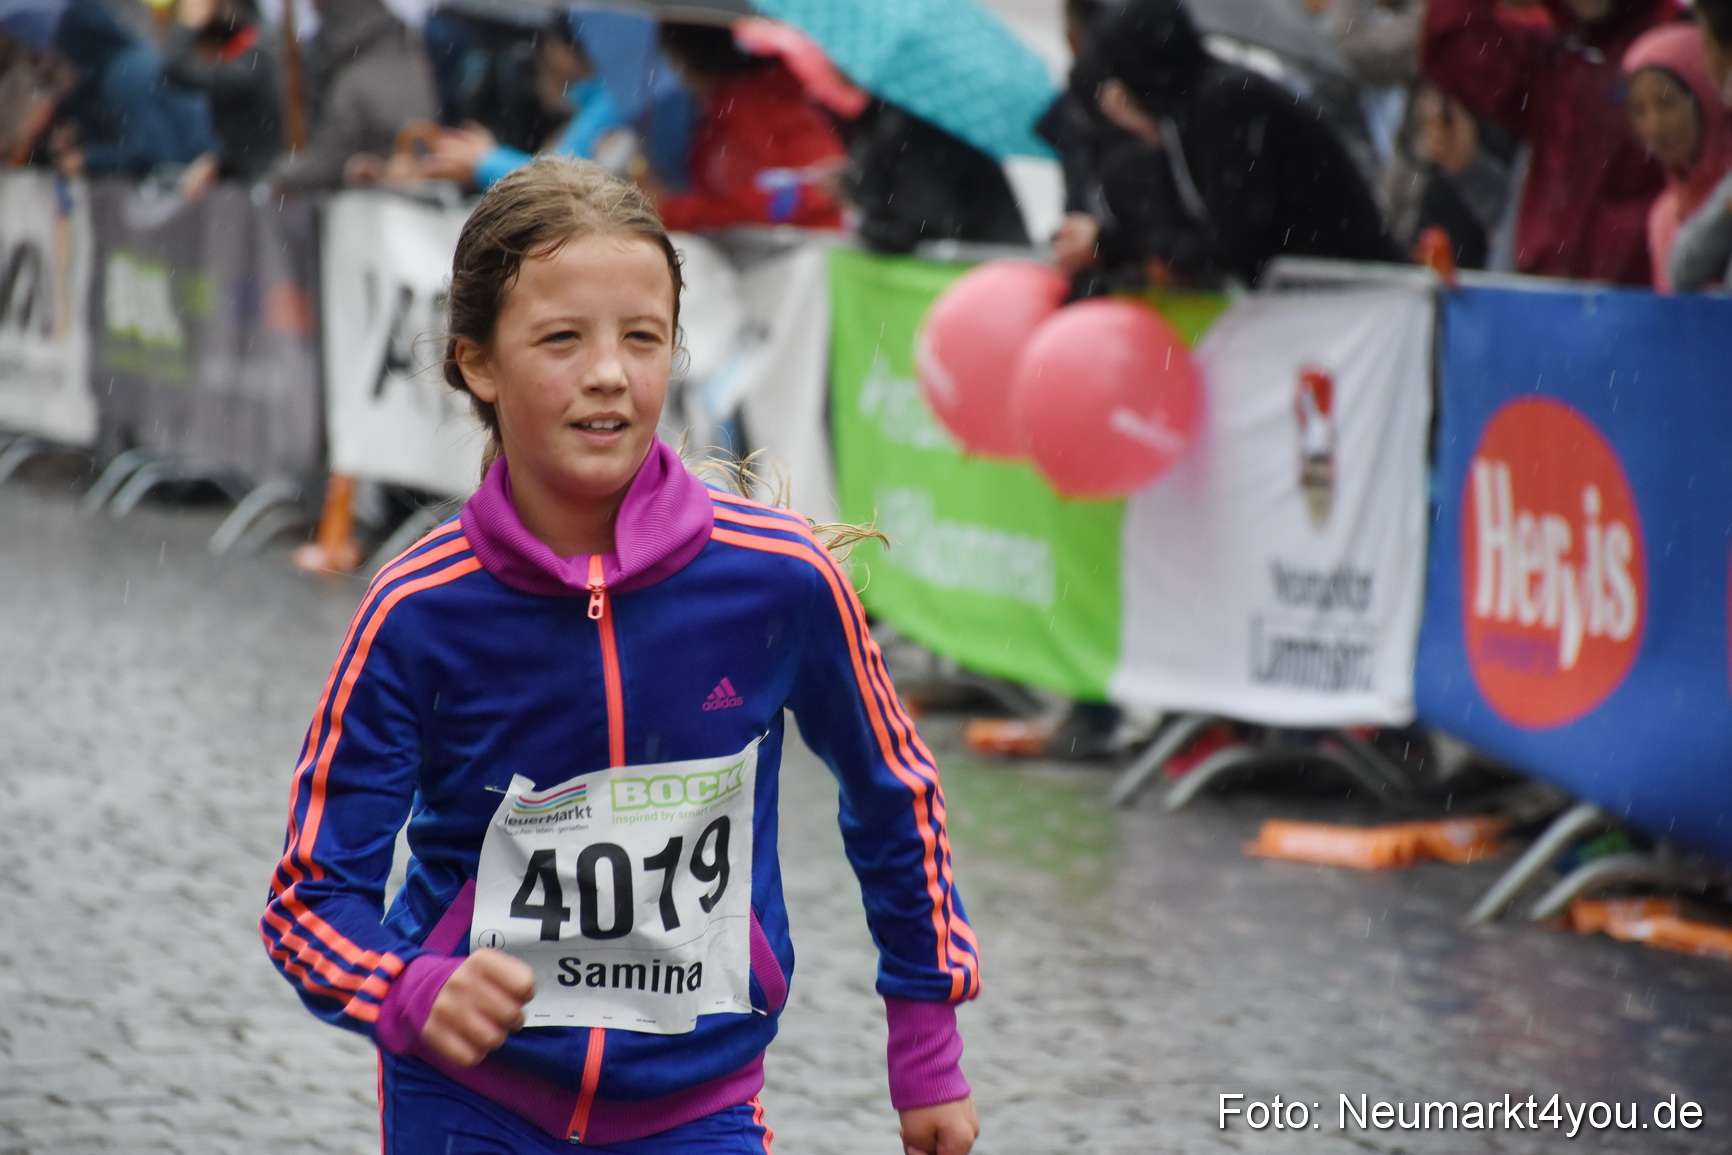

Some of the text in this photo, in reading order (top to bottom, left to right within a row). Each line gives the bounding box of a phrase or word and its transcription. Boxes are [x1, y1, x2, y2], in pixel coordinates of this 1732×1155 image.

[702, 696, 744, 712] adidas
[612, 762, 744, 811] BOCK
[612, 805, 709, 825] inspired by smart
[509, 814, 731, 942] 4019
[557, 956, 702, 994] Samina
